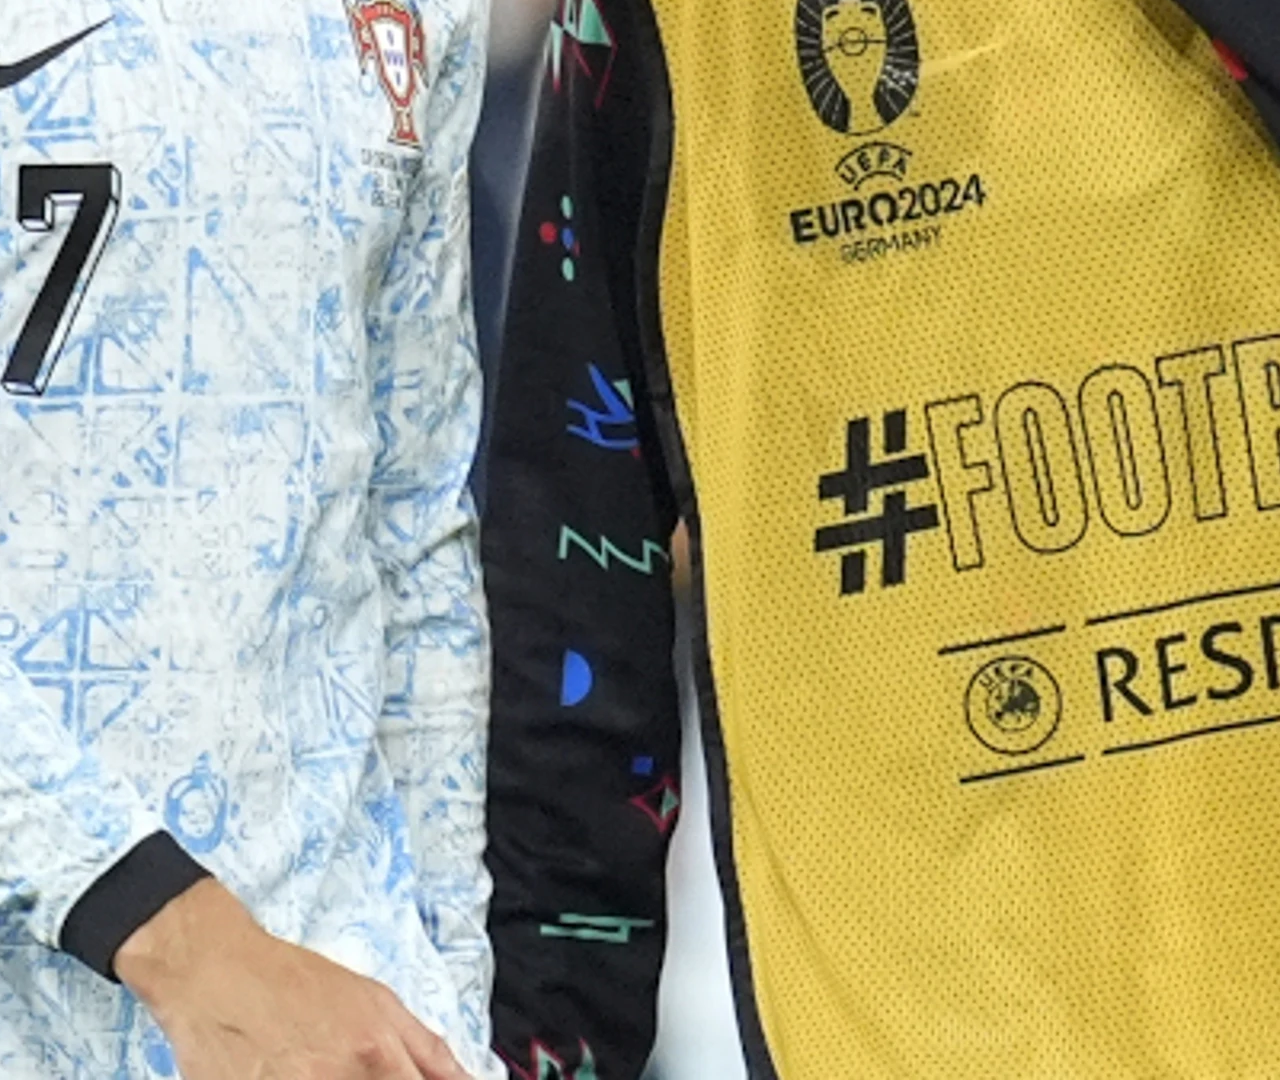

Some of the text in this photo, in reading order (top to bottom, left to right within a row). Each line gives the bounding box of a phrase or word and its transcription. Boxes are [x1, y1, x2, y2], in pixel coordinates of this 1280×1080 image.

[838, 148, 907, 185] UEFA
[790, 173, 987, 244] EURO2024
[840, 225, 942, 262] GERMANY
[0, 162, 122, 397] 7
[978, 663, 1034, 691] UEFA
